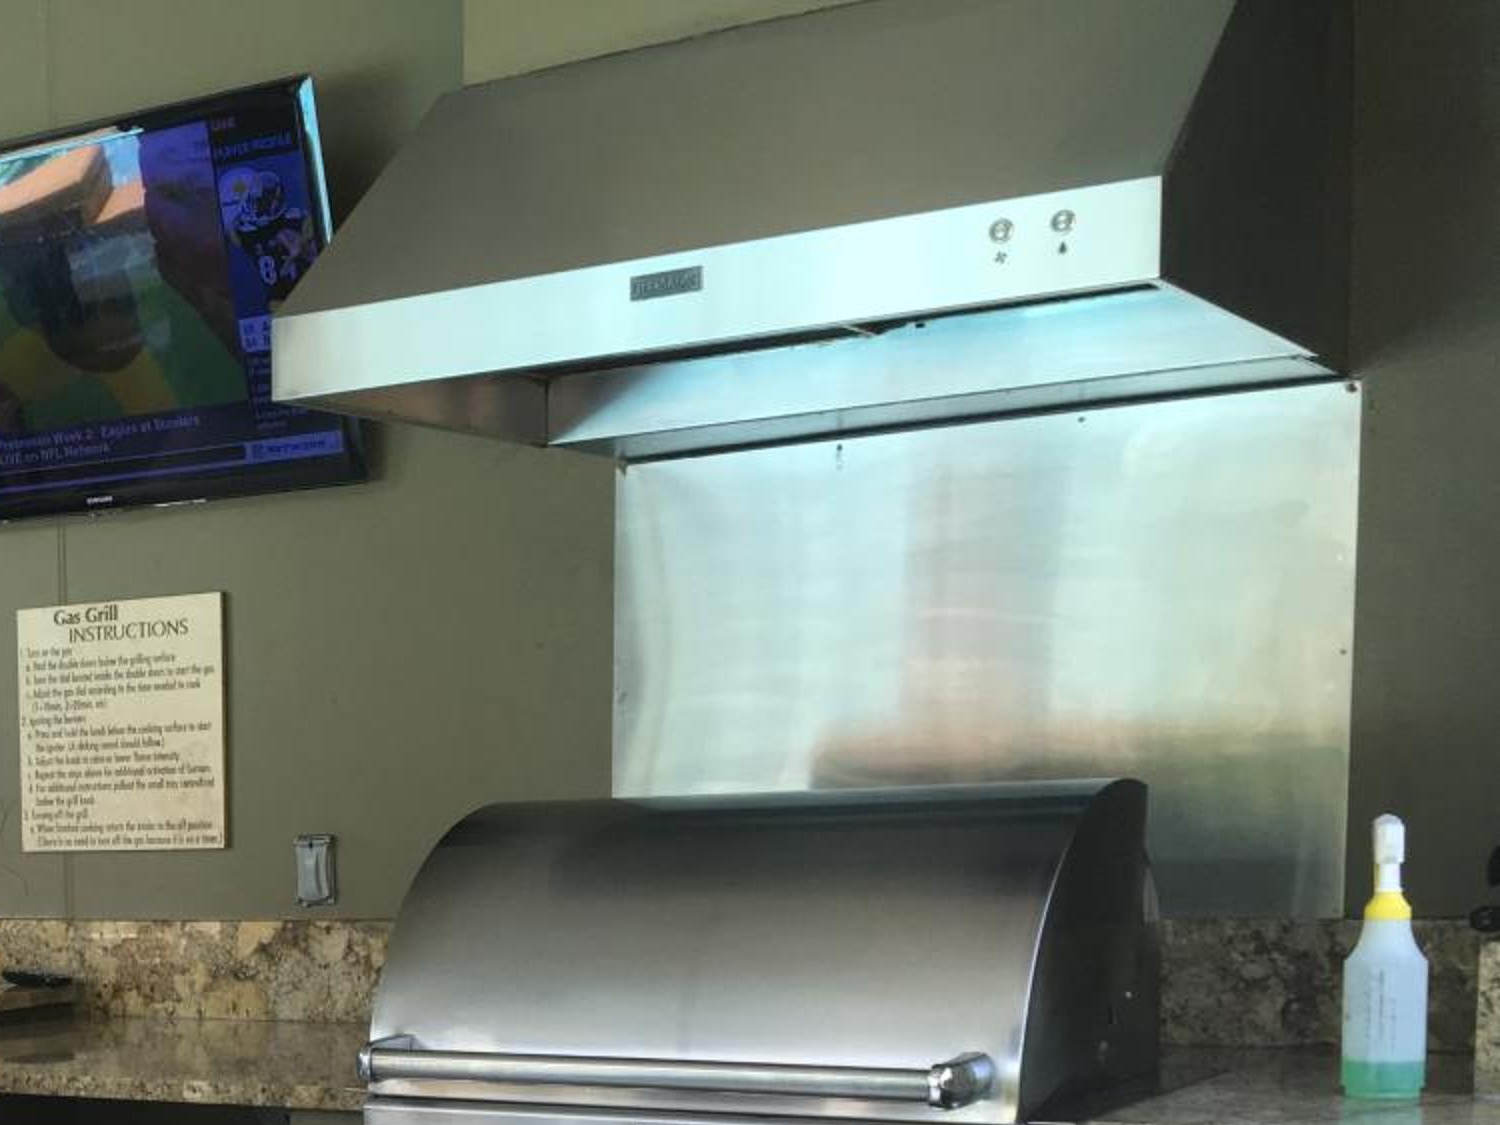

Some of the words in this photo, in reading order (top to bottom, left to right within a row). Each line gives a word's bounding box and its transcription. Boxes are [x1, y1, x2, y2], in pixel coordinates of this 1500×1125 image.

[54, 609, 81, 625] Gas
[86, 605, 119, 623] Grill
[69, 618, 189, 643] INSTRUCTIONS
[118, 654, 127, 665] the
[114, 668, 123, 679] the
[191, 663, 200, 673] the
[52, 686, 61, 696] the
[126, 681, 135, 692] the
[79, 725, 88, 736] the
[127, 723, 136, 733] the
[135, 779, 145, 789] the
[56, 796, 64, 805] the
